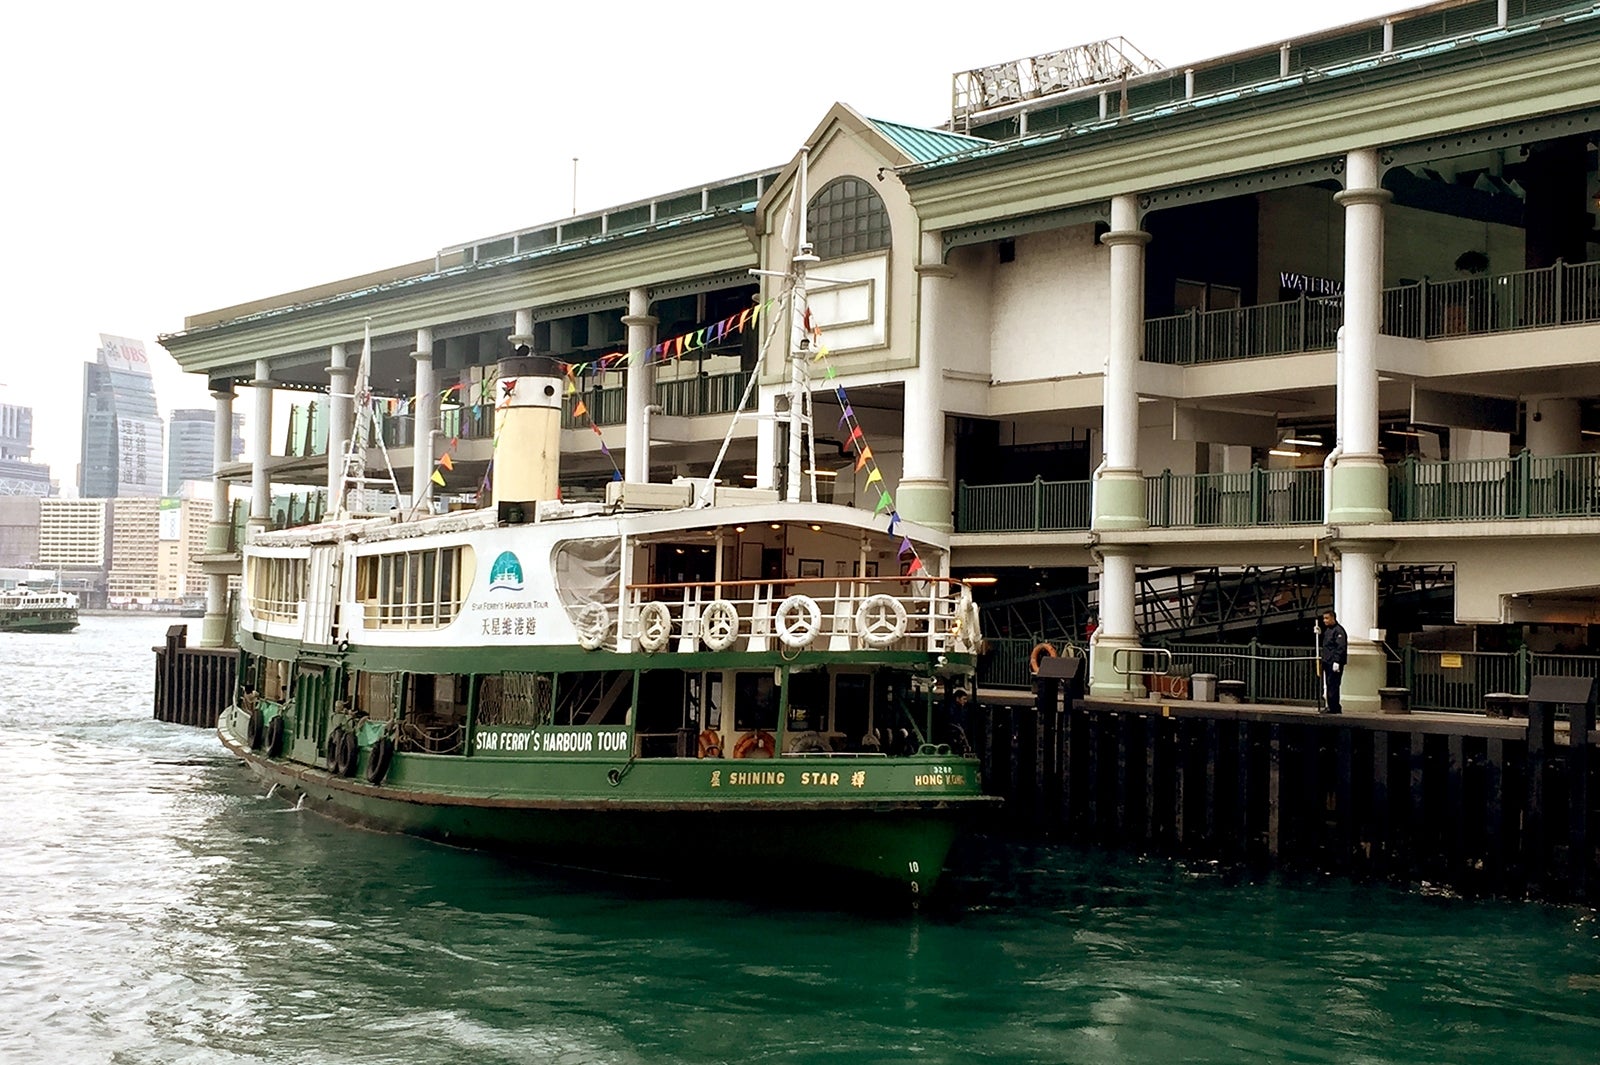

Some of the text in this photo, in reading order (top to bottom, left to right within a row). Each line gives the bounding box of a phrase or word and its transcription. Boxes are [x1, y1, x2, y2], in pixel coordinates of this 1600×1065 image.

[120, 345, 148, 364] UBS
[120, 419, 133, 485] 理財有道
[476, 730, 628, 752] STAR FERRY'S HARBOUR TOUR
[710, 770, 721, 787] 星
[729, 771, 840, 786] SHINING STAR
[914, 774, 944, 787] HONG
[908, 861, 920, 873] 10
